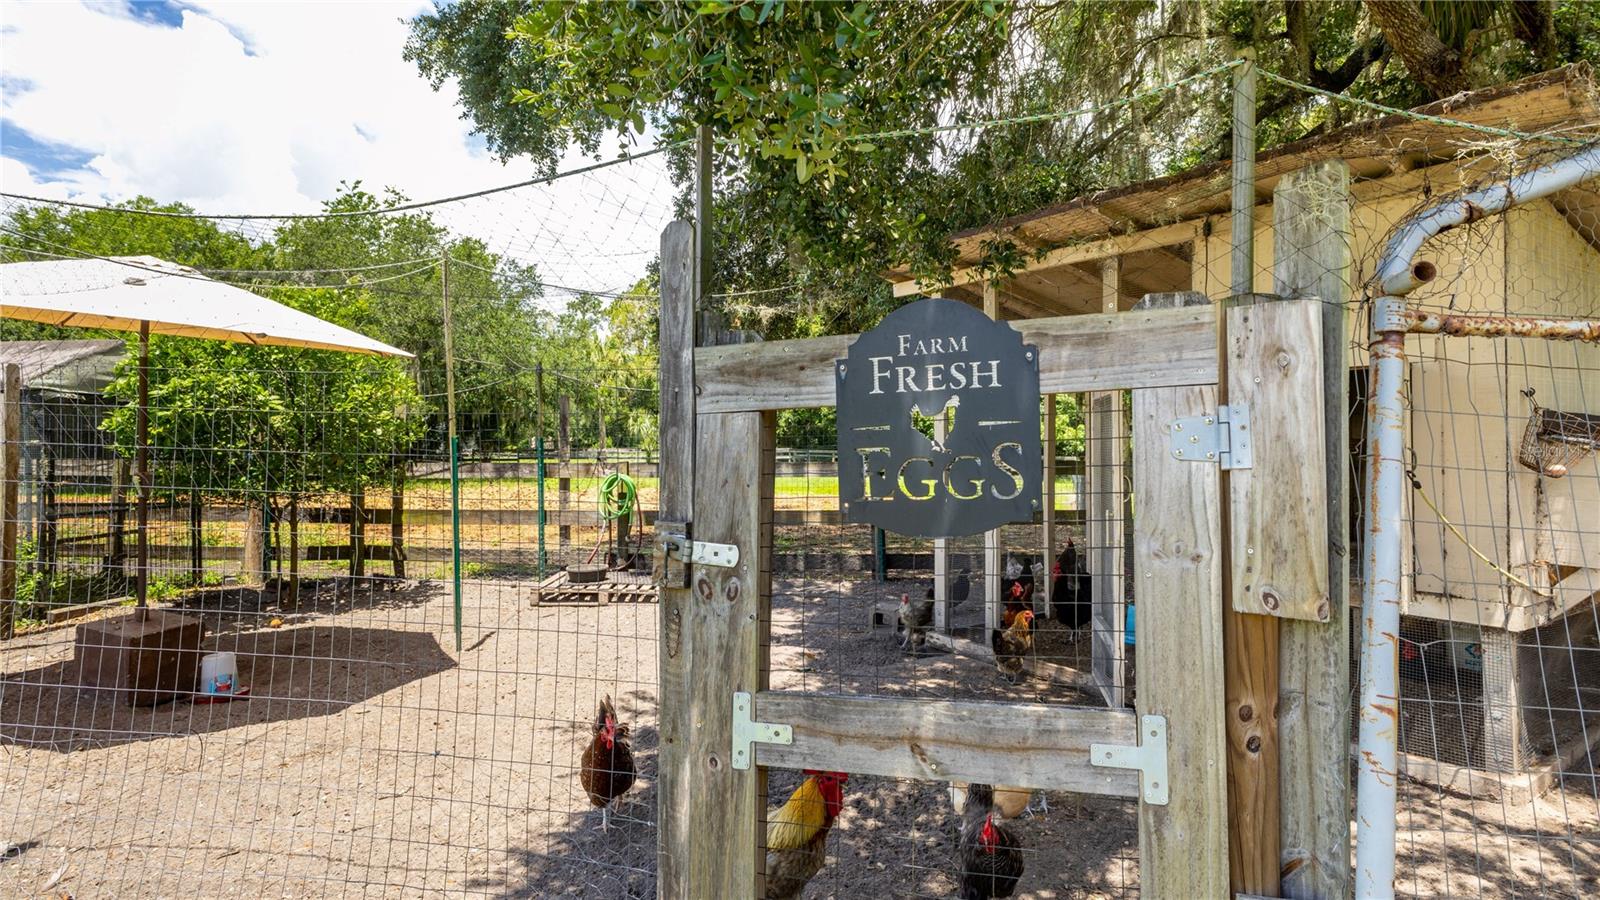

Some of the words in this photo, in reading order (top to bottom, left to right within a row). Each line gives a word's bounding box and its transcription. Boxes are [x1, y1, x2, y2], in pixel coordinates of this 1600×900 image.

[897, 334, 969, 357] FARM
[868, 356, 1002, 395] FRESH
[856, 442, 1025, 500] EGGS
